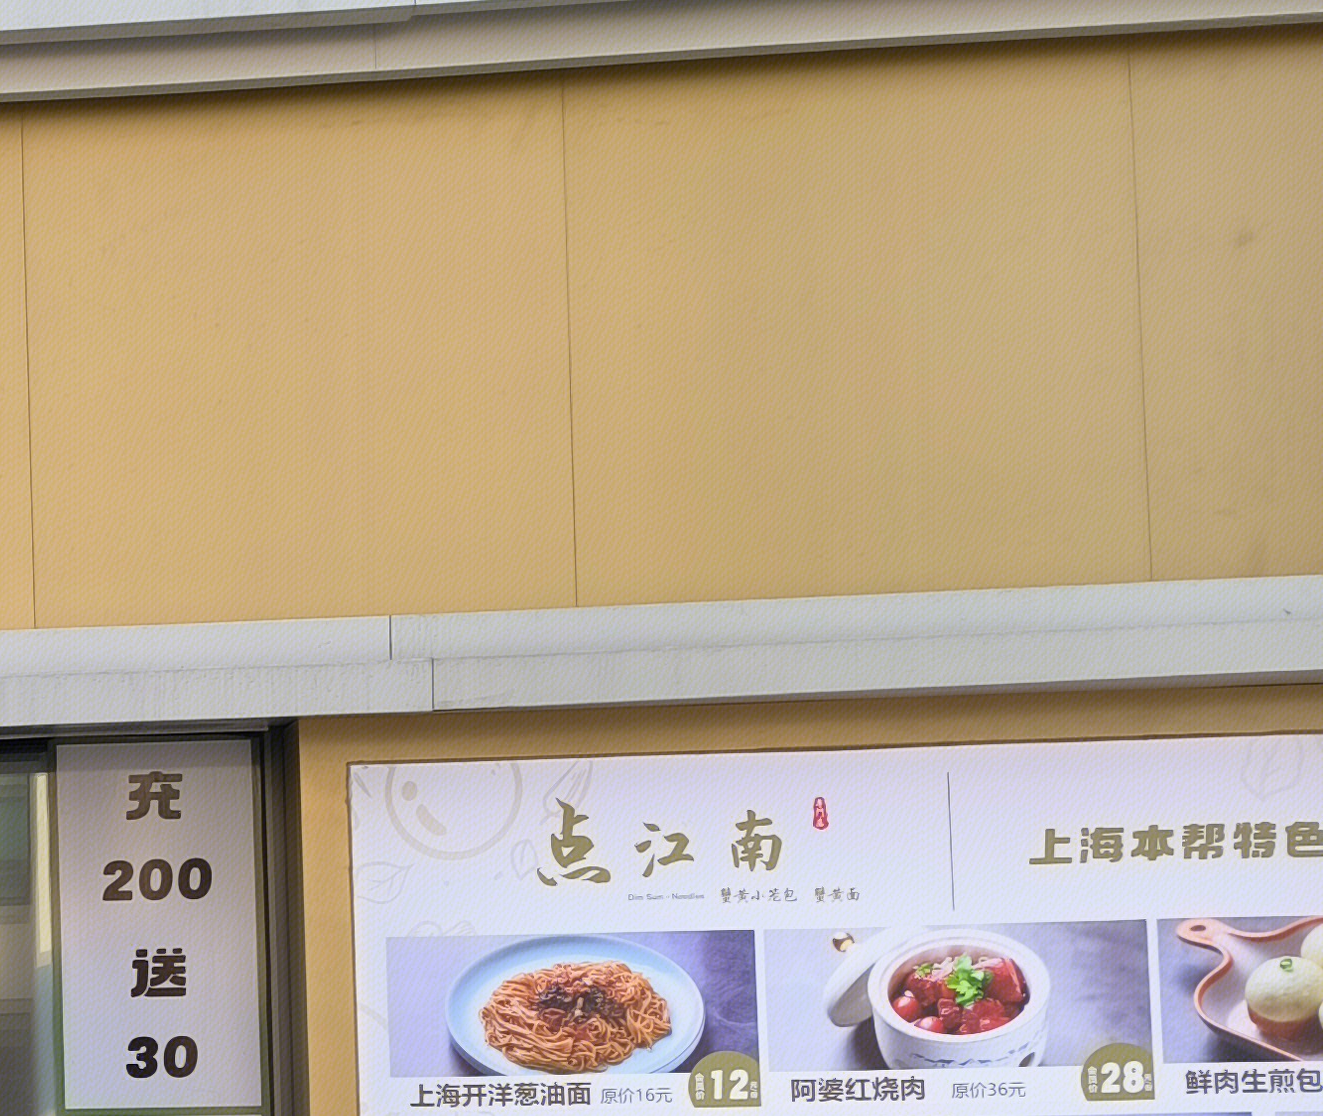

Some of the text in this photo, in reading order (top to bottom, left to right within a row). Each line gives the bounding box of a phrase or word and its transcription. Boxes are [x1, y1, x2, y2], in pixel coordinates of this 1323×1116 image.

[126, 771, 183, 820] 充
[537, 798, 783, 886] 点江南
[1029, 821, 1323, 865] 上海本帮特色
[102, 858, 212, 901] 200
[131, 948, 186, 997] 送
[126, 1036, 198, 1078] 30
[1101, 1060, 1145, 1094] 28
[410, 1081, 673, 1108] 上海开洋葱油面 原价16元
[711, 1069, 749, 1100] 12
[790, 1076, 1027, 1104] 阿婆红烧肉 原价36元
[1185, 1068, 1323, 1095] 鲜肉生煎包
